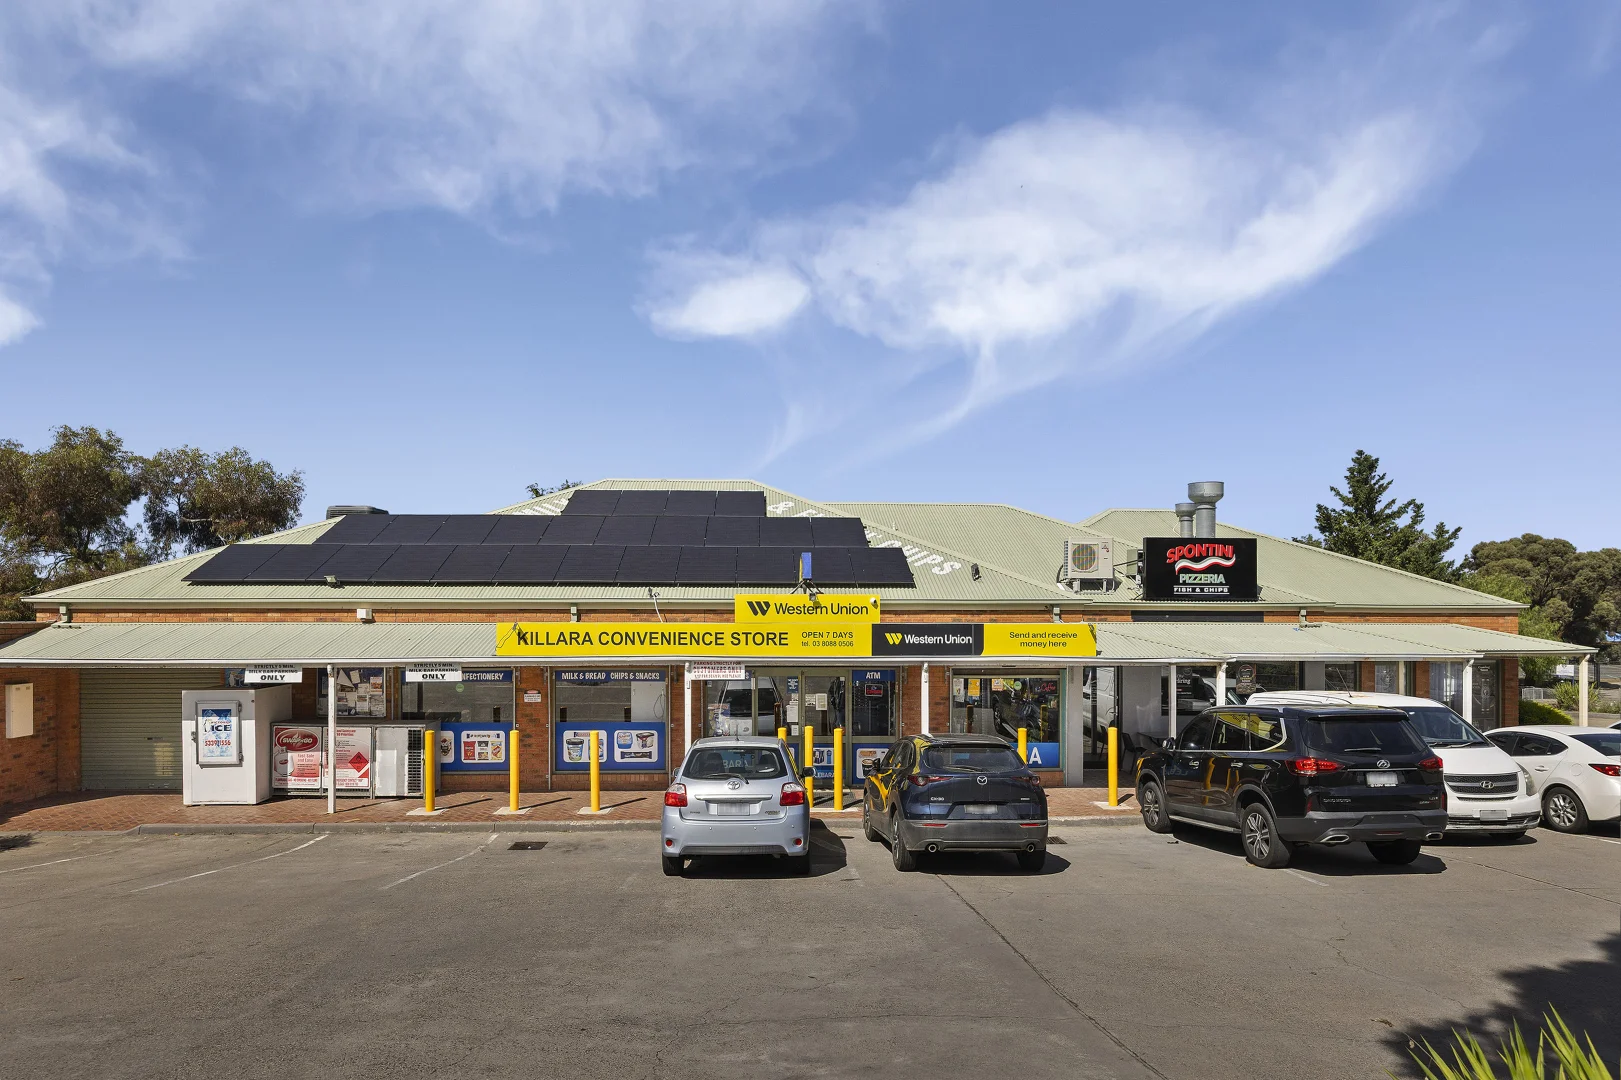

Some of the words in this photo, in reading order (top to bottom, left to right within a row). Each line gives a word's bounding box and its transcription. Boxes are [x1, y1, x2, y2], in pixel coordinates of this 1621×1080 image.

[1166, 543, 1235, 563] SPONTINI
[1179, 573, 1226, 584] PIZZERIA
[774, 602, 828, 615] Western
[830, 602, 869, 615] Union
[517, 631, 594, 646] KILLARA
[598, 631, 725, 646] CONVENIENCE
[730, 631, 789, 646] STORE
[801, 631, 825, 639] OPEN
[827, 631, 831, 639] 7
[832, 631, 854, 639] DAYS
[904, 633, 944, 644] Western
[944, 633, 972, 644] Union
[1009, 631, 1031, 639] Send
[1032, 631, 1047, 639] and
[1048, 631, 1078, 639] receive
[561, 672, 579, 680] MILK
[580, 672, 585, 680] &
[586, 672, 606, 680] BREAD
[610, 672, 629, 680] CHIPS
[630, 672, 635, 680] &
[636, 672, 660, 680] SNACKS
